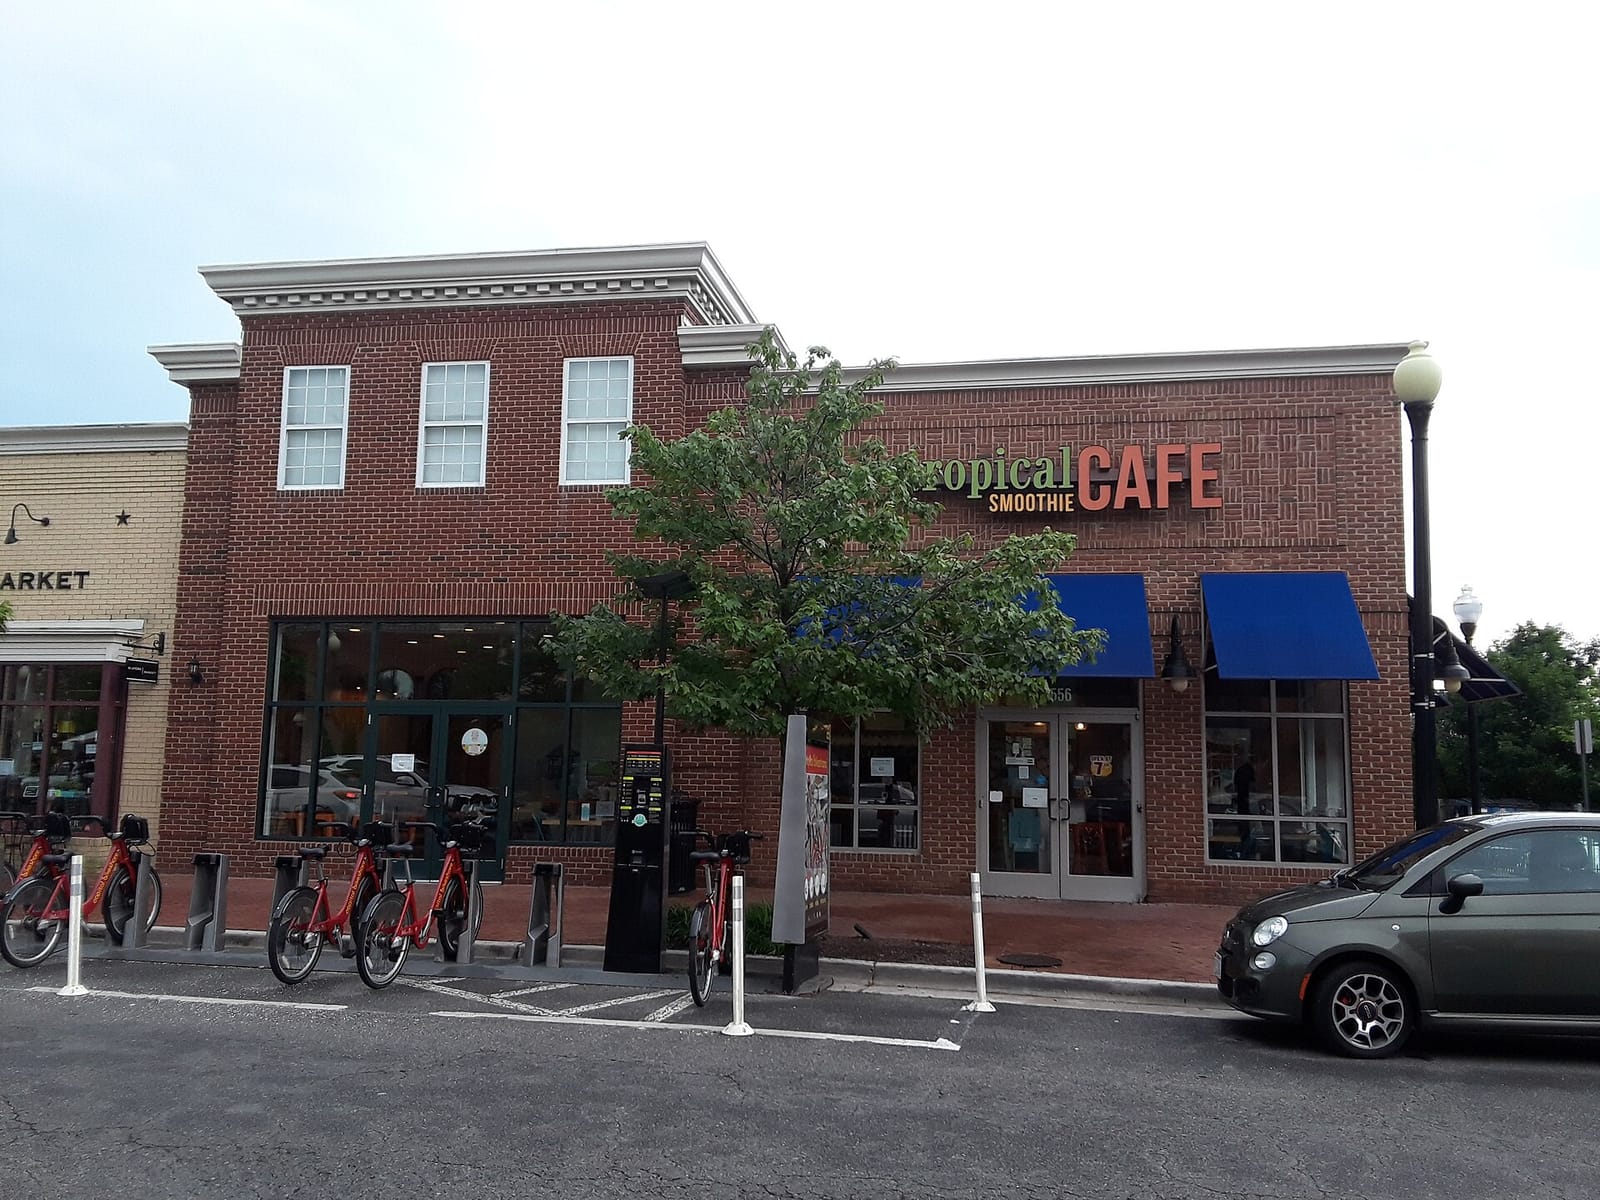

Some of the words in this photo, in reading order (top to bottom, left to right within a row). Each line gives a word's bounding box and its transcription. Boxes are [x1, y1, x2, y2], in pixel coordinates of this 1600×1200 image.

[913, 446, 1075, 499] ropical
[1078, 443, 1223, 511] CAFE
[989, 493, 1075, 512] SMOOTHIE
[0, 571, 90, 590] ARKET
